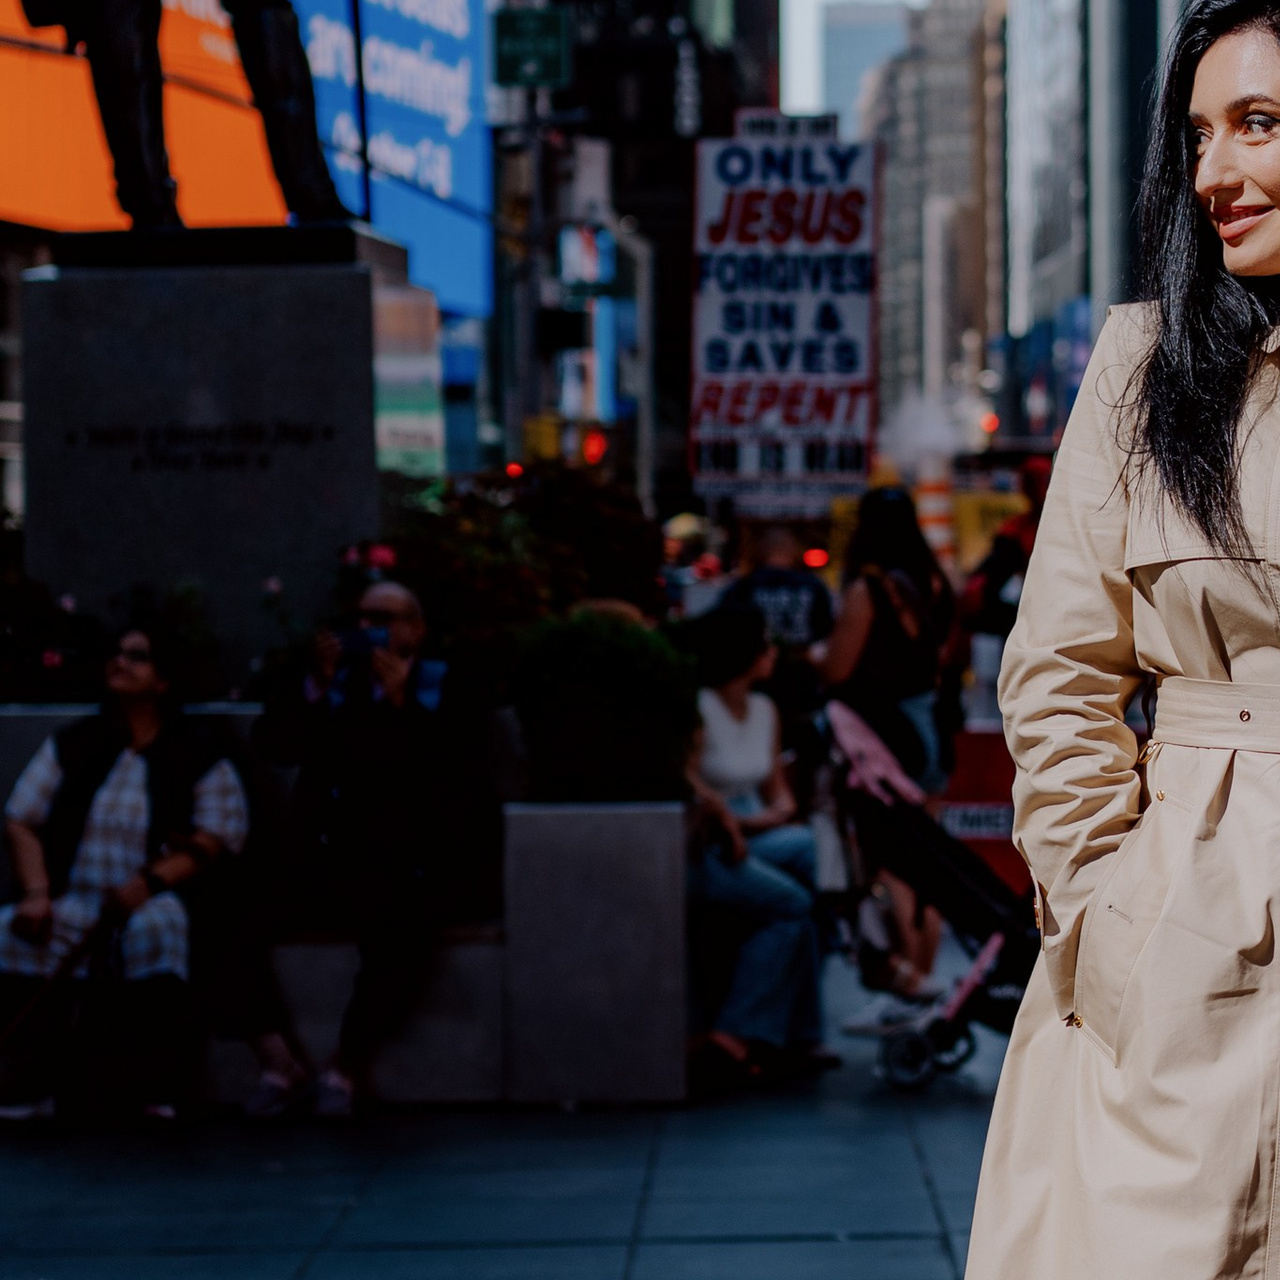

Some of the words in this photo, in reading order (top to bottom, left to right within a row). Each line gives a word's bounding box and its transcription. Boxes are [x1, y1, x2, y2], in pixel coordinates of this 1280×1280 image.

[716, 145, 860, 186] ONLY
[708, 190, 868, 245] JESUS
[698, 253, 873, 294] FORGIVES
[722, 300, 795, 333] SIN
[705, 338, 860, 374] SAVES
[699, 378, 871, 428] REPENT
